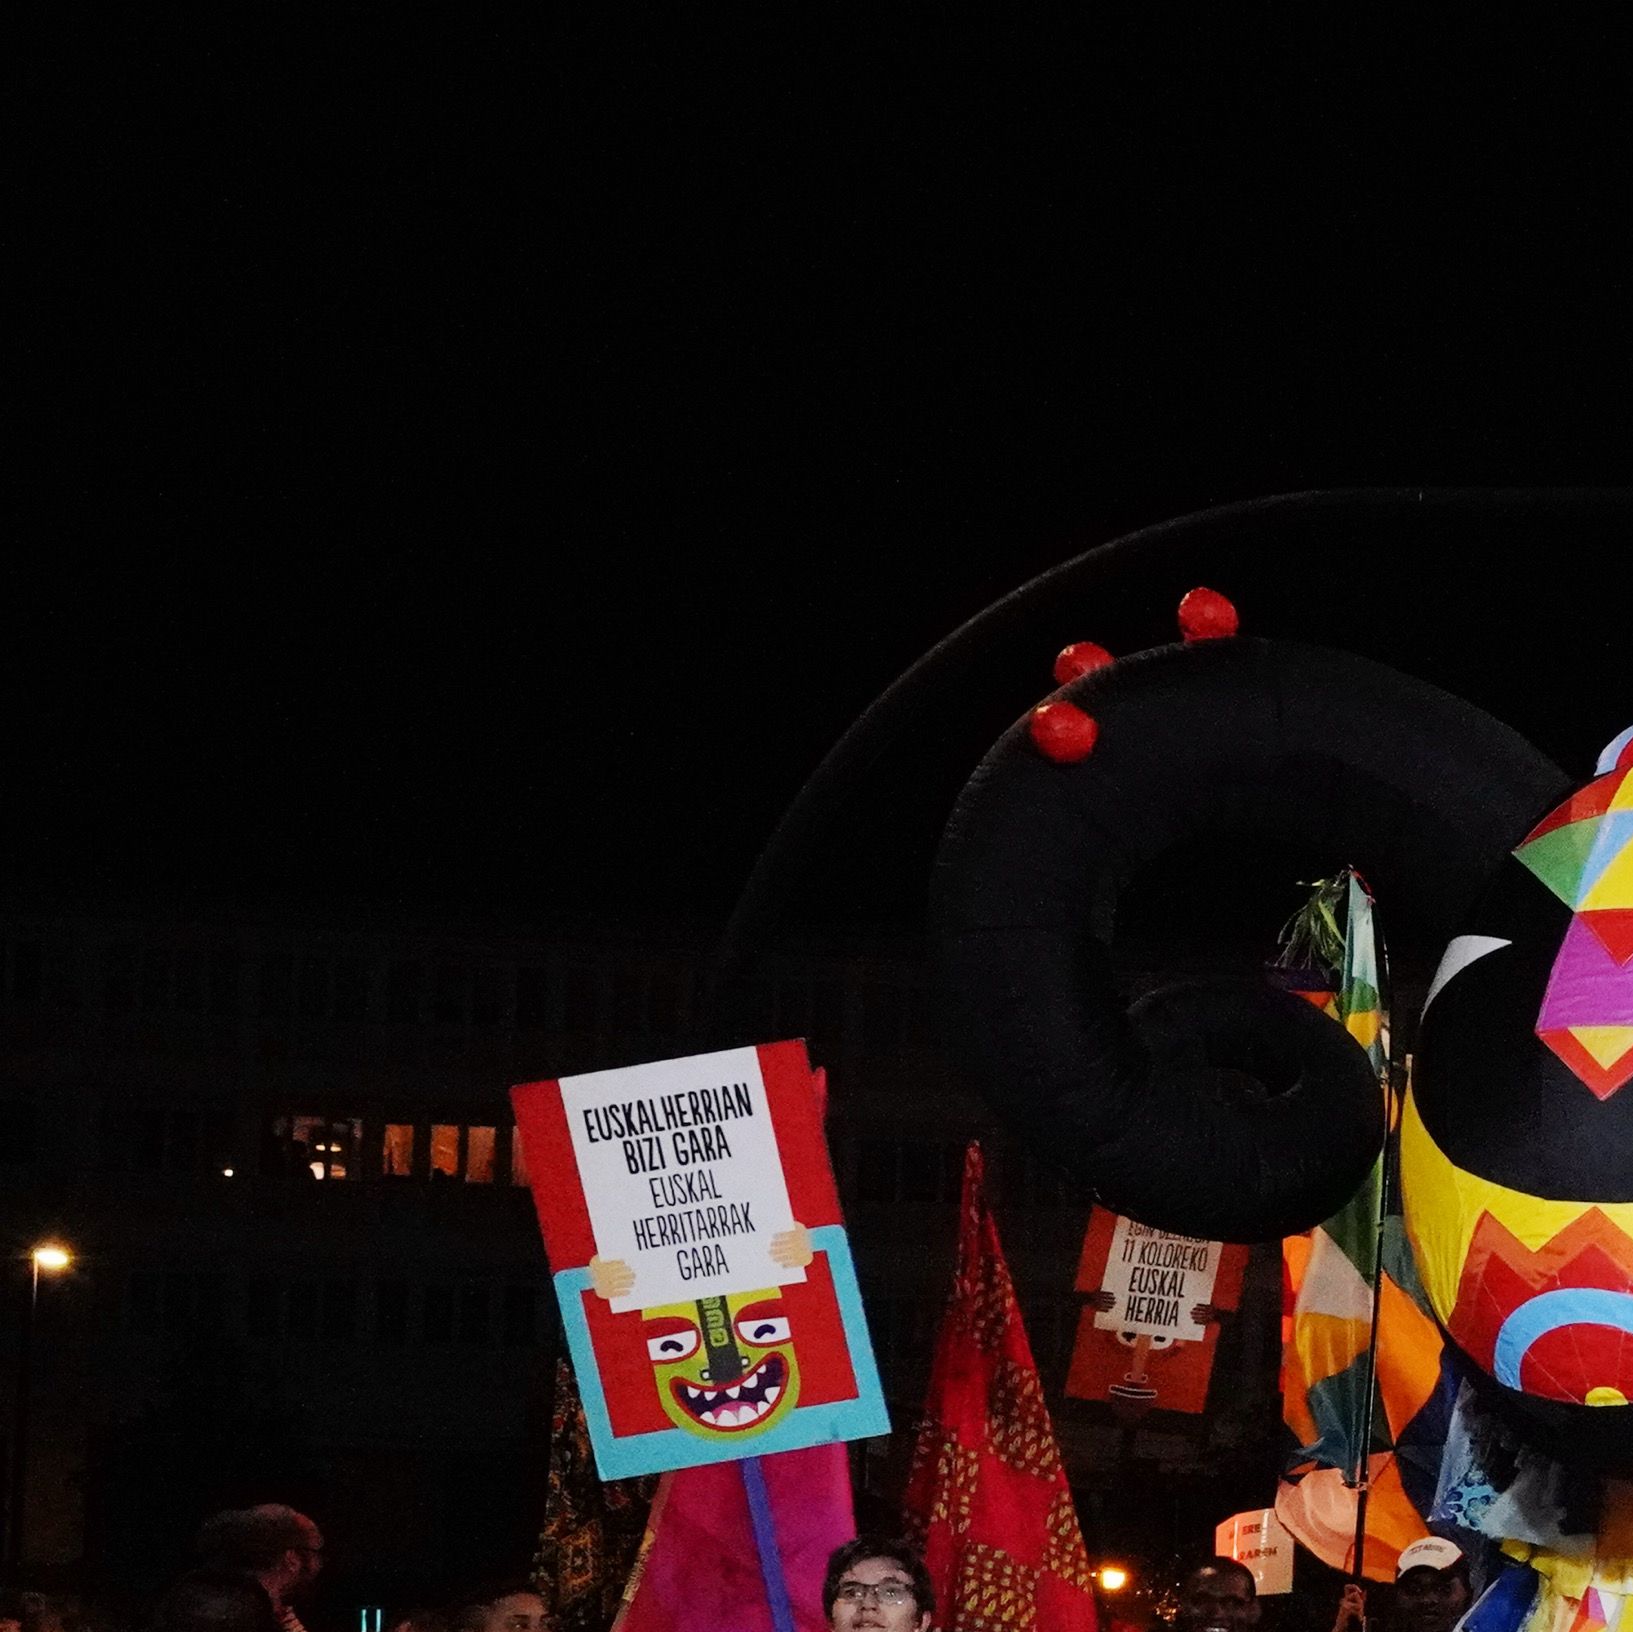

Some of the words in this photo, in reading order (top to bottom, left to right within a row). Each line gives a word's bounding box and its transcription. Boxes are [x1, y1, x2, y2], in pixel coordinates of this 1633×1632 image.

[583, 1083, 753, 1142] EUSKALHERRIAN
[623, 1135, 666, 1175] BIZI
[675, 1125, 732, 1163] GARA
[649, 1170, 722, 1208] EUSKAL
[633, 1203, 756, 1250] HERRITARRAK
[677, 1244, 729, 1280] GARA
[1138, 1241, 1208, 1272] KOLOREKO
[1128, 1266, 1185, 1298] EUSKAL
[1124, 1295, 1179, 1327] HERRIA
